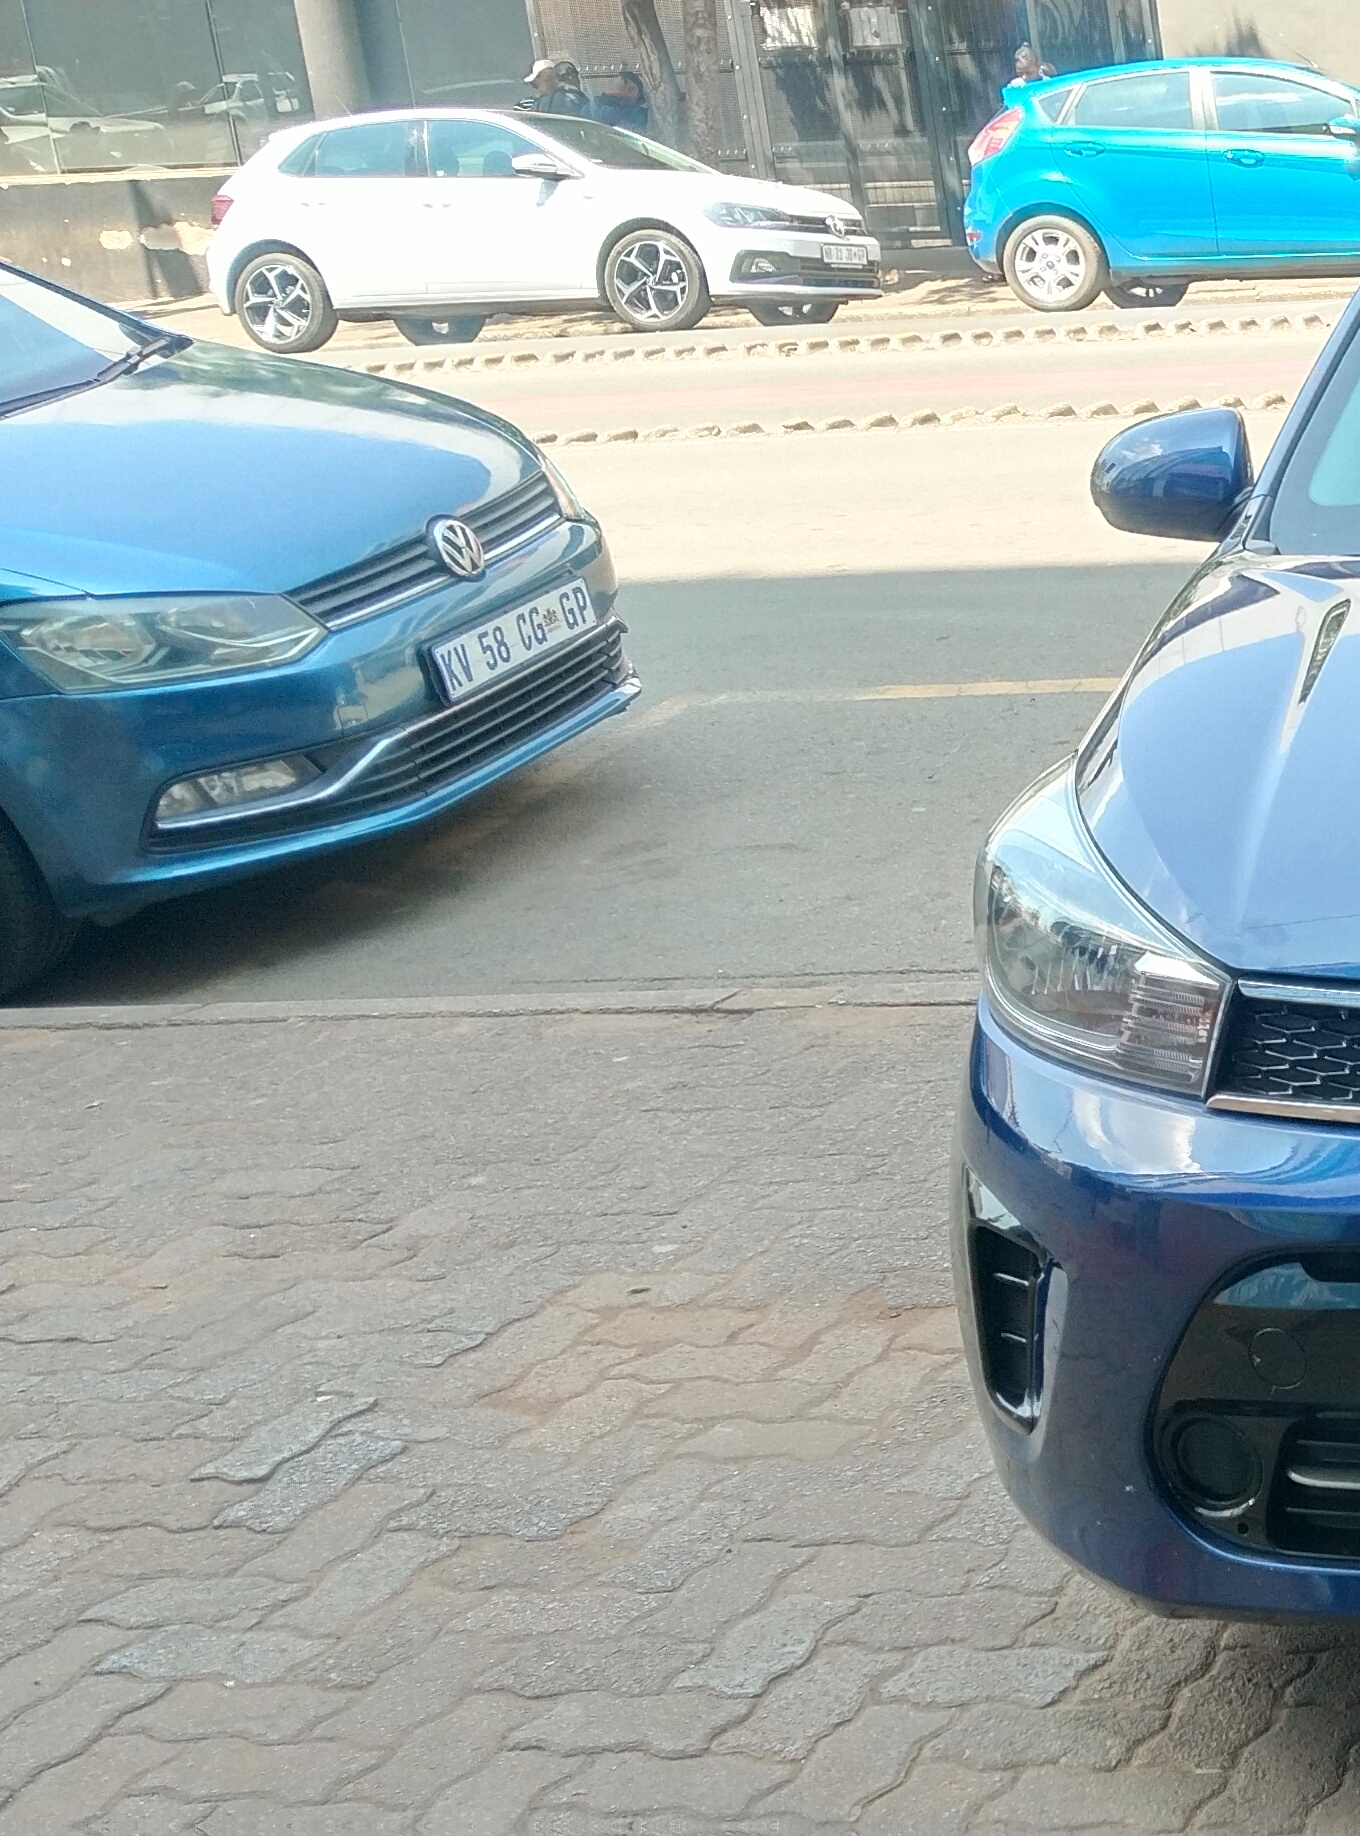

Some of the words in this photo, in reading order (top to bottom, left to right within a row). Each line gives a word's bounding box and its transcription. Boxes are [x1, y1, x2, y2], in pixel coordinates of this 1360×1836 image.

[440, 643, 474, 691] KV
[477, 625, 511, 671] 58
[516, 606, 548, 652] CG
[559, 586, 588, 630] GP
